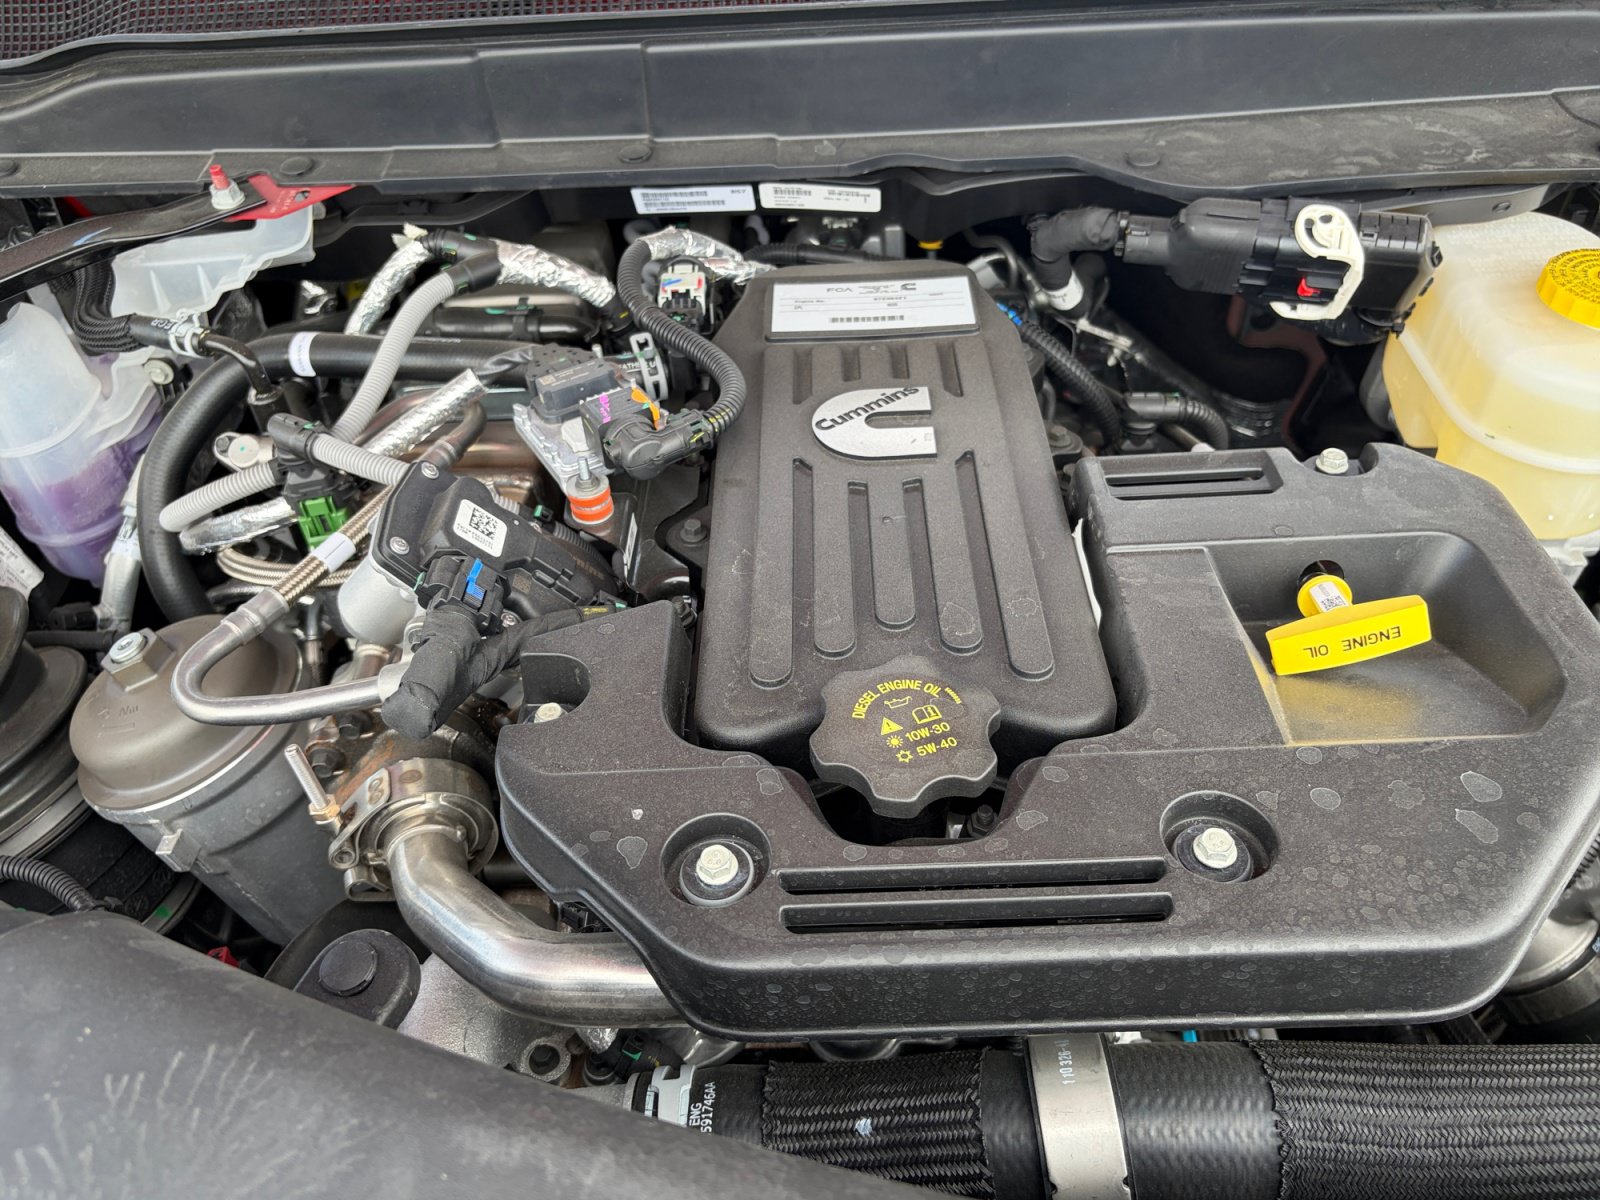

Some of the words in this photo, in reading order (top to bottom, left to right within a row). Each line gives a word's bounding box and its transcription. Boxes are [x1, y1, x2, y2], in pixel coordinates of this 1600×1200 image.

[815, 386, 920, 431] Cummins
[1303, 644, 1329, 658] OIL
[1341, 626, 1401, 651] ENGINE
[851, 690, 881, 719] DIESEL
[876, 679, 923, 694] ENGINE
[923, 683, 942, 698] OIL
[905, 722, 951, 742] 10W-30
[916, 736, 958, 757] 5W-40
[688, 1102, 702, 1127] ENG
[700, 1081, 717, 1133] 591746AA
